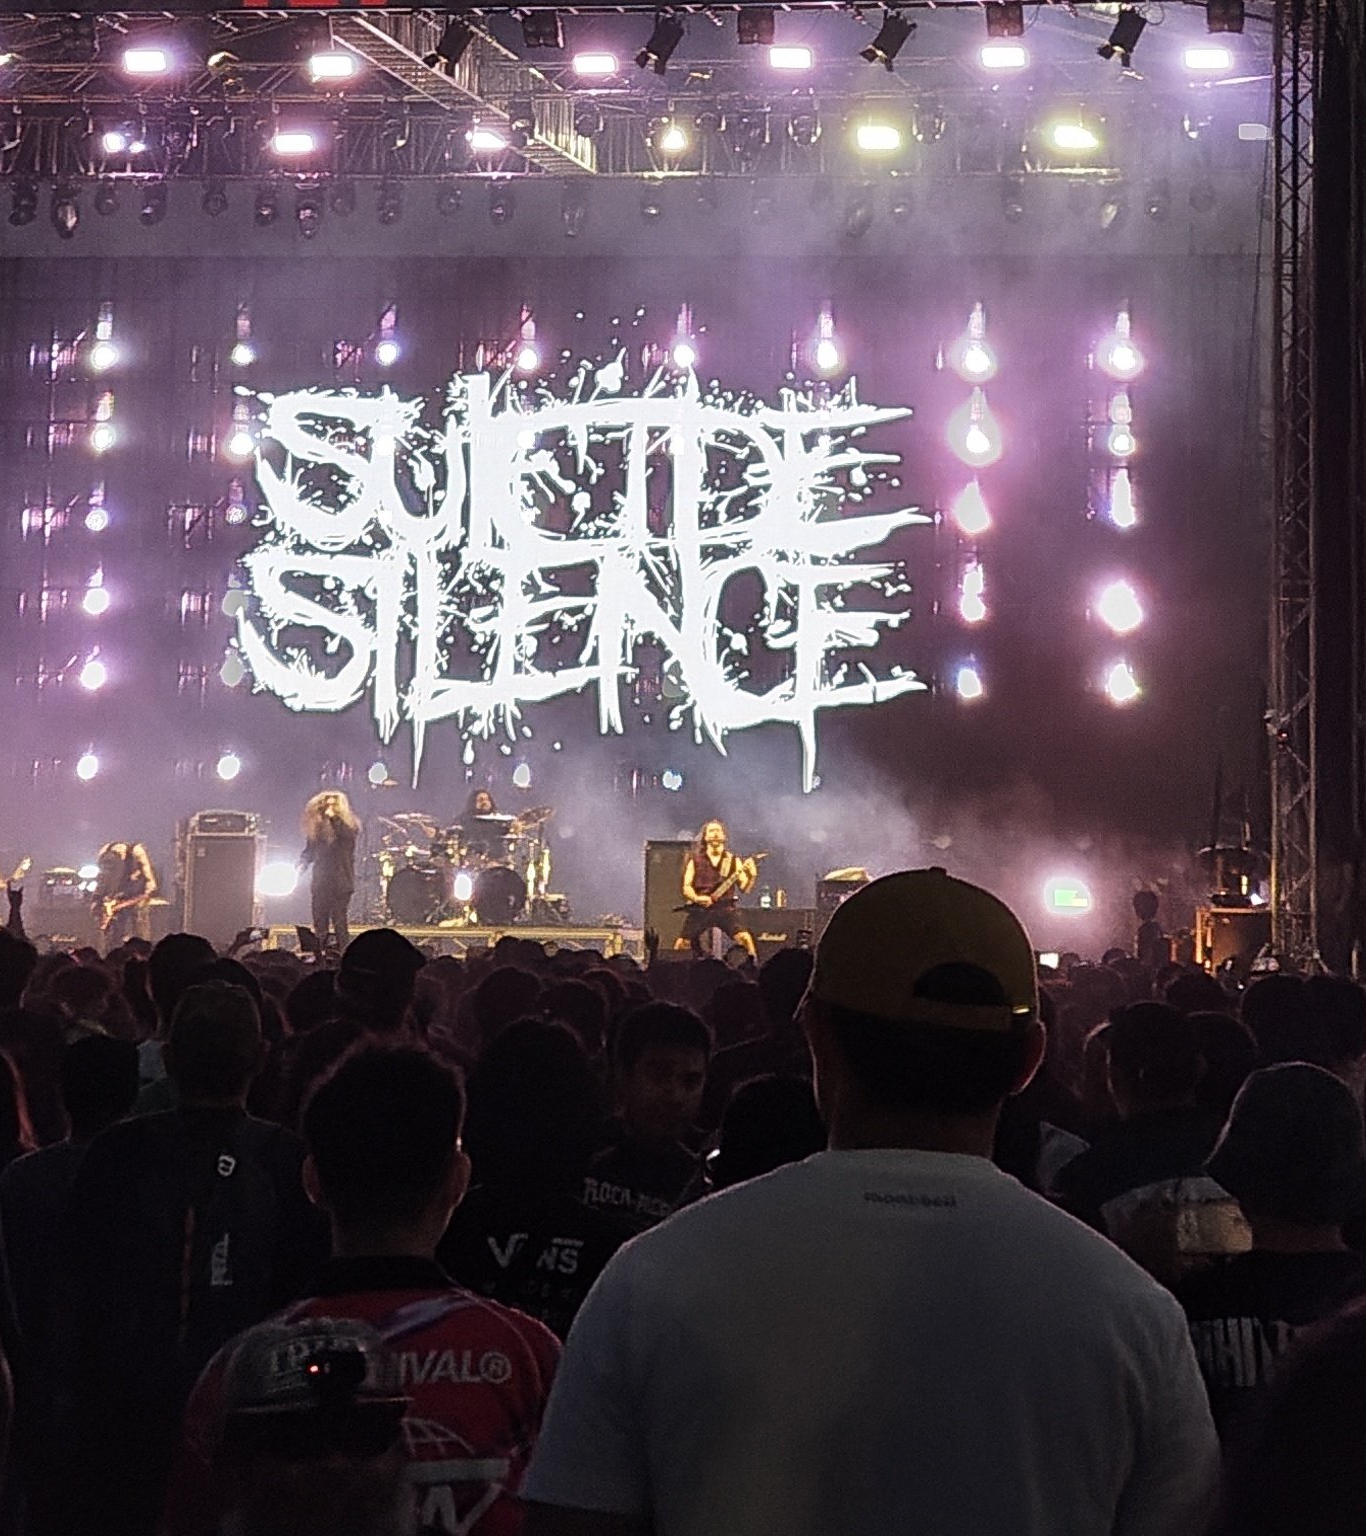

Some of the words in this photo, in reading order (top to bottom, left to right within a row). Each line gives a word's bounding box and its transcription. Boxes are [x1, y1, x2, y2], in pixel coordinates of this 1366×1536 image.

[249, 359, 932, 550] SUICIDE
[233, 544, 927, 792] SILENCE
[487, 1233, 585, 1275] VNS
